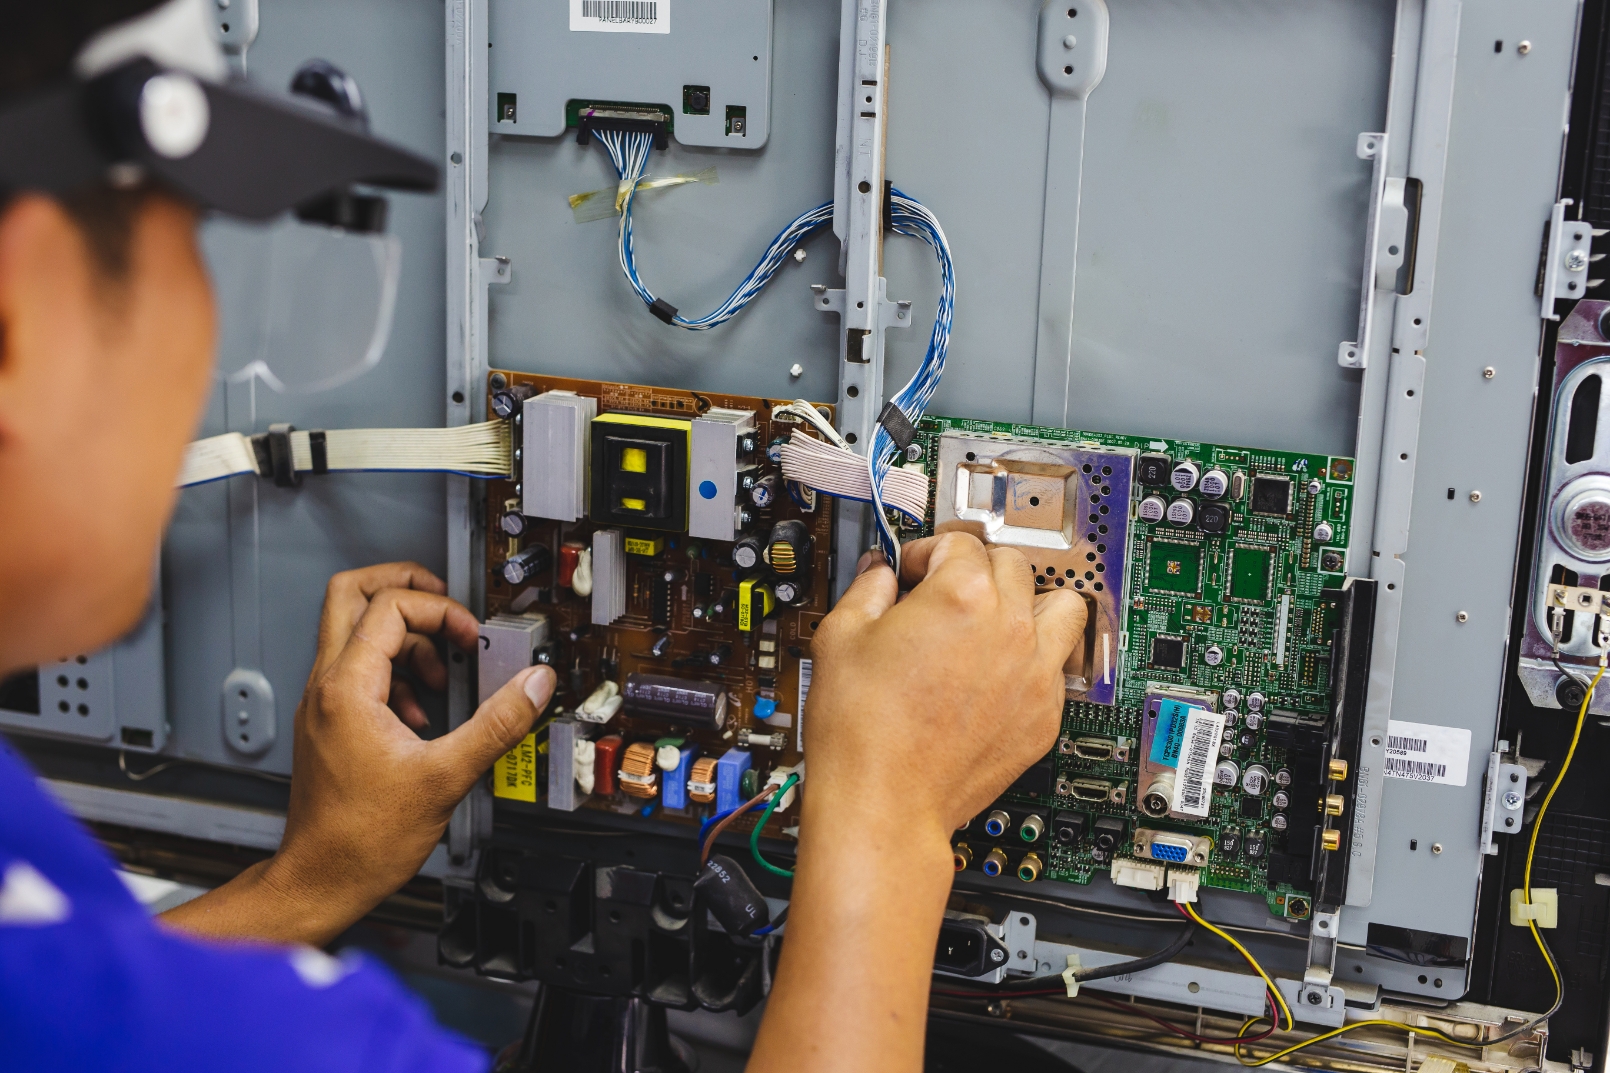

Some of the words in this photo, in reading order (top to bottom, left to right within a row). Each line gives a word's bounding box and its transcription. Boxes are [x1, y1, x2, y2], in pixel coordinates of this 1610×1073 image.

[1148, 466, 1157, 479] 220
[1205, 514, 1219, 523] 220
[789, 621, 797, 640] COLD
[745, 674, 754, 693] HOT
[505, 745, 518, 789] -0717DK
[521, 743, 533, 787] LM2-PFC
[706, 859, 731, 884] 22852
[744, 903, 758, 919] UL
